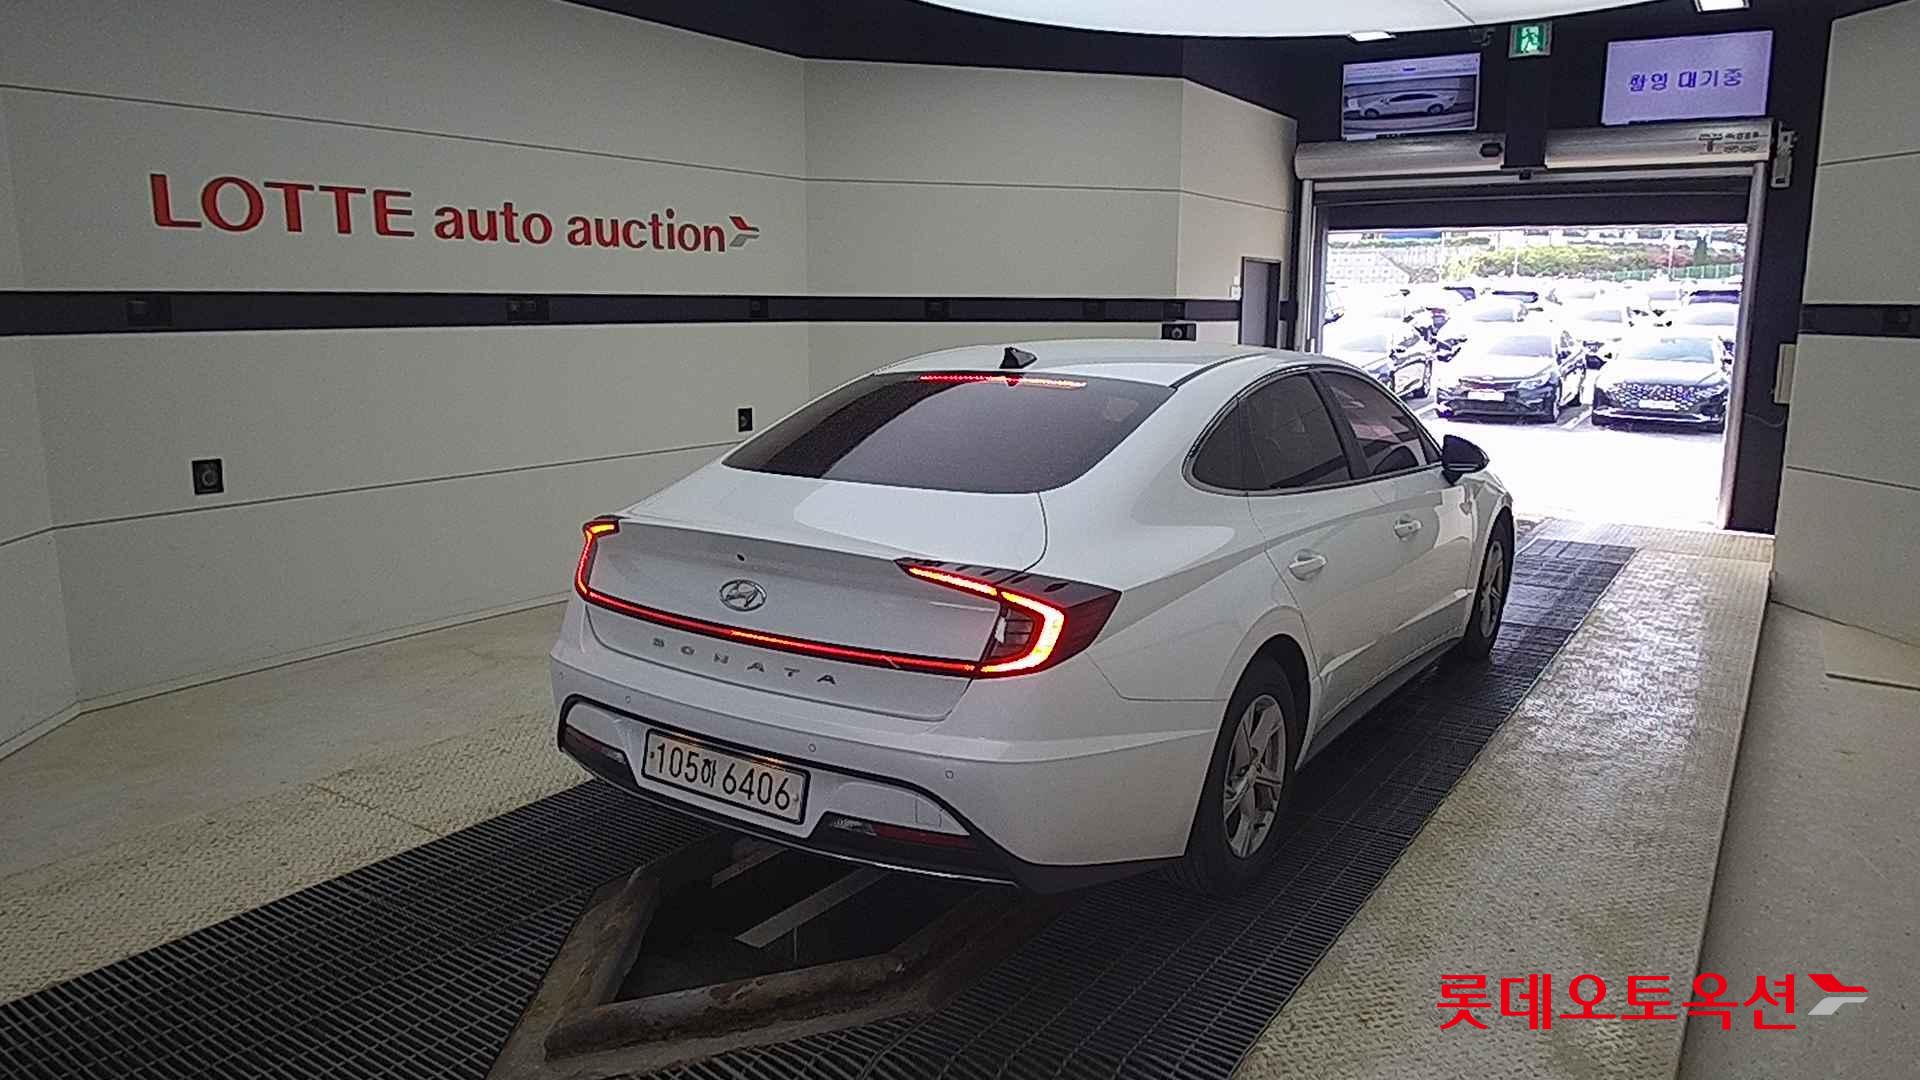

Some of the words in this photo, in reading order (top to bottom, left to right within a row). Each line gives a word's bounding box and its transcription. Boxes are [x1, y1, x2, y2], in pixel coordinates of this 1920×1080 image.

[1678, 68, 1742, 88] 대기중
[150, 173, 415, 237] LOTTE
[434, 202, 553, 245] auto
[566, 209, 726, 253] auction
[653, 637, 836, 685] SONATA
